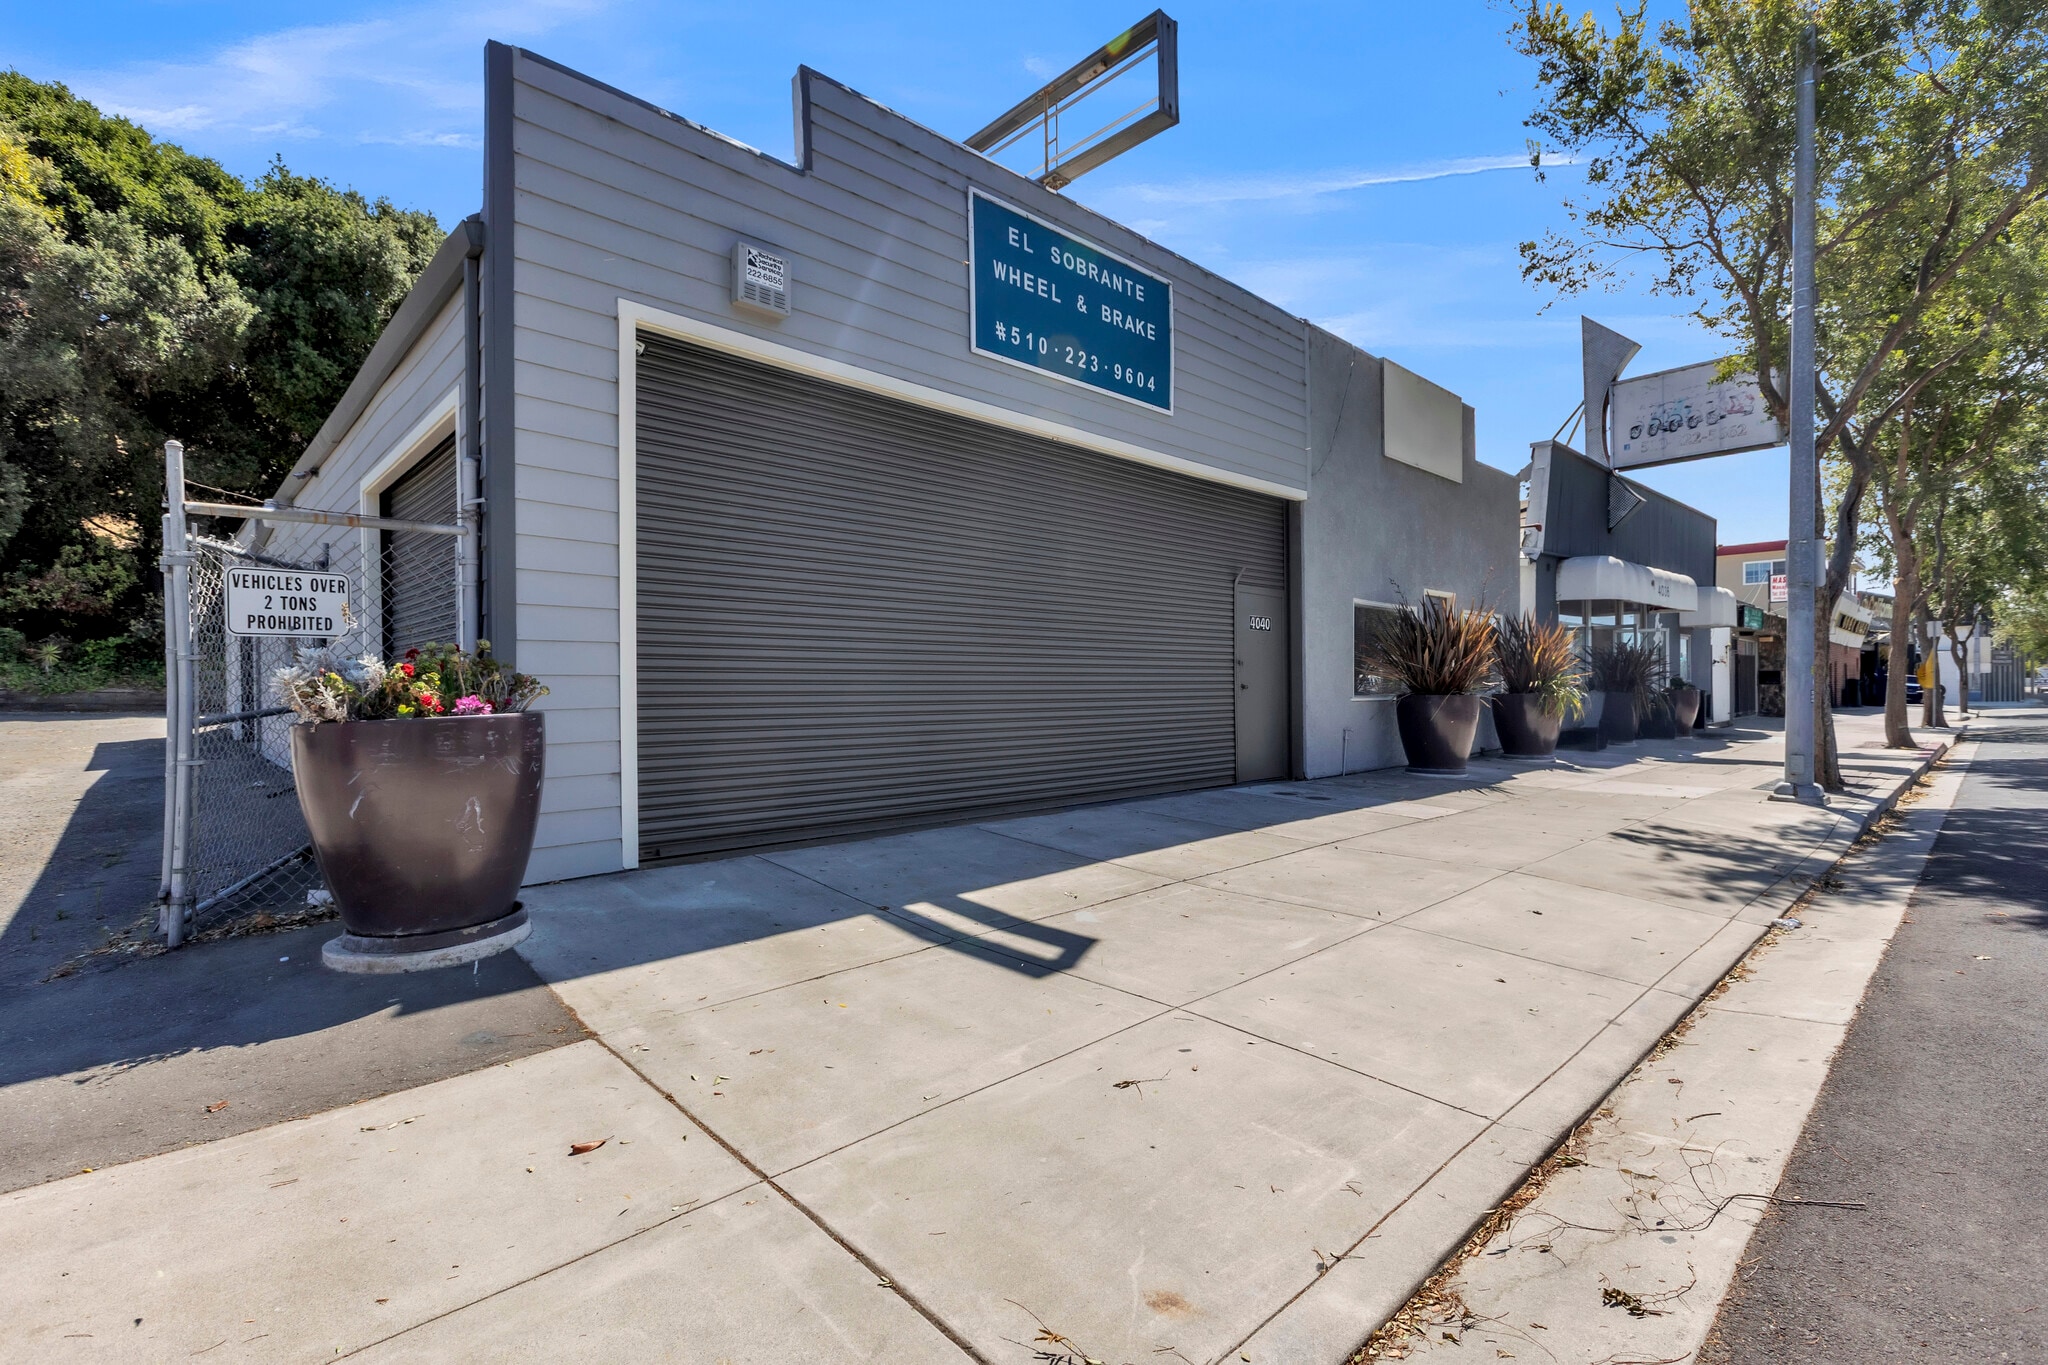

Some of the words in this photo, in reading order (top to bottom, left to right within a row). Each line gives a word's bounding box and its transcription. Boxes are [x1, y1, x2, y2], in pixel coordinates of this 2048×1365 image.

[1008, 226, 1034, 254] EL
[1050, 246, 1145, 302] SOBRANTE
[747, 268, 783, 286] 222-6855
[993, 259, 1062, 304] WHEEL
[1077, 294, 1088, 314] &
[1101, 304, 1156, 341] BRAKE
[232, 573, 303, 592] VEHICLES
[310, 578, 346, 594] OVER
[264, 595, 273, 610] 2
[280, 596, 317, 612] TONS
[247, 614, 333, 631] PROHIBITED
[1250, 616, 1271, 631] 4040
